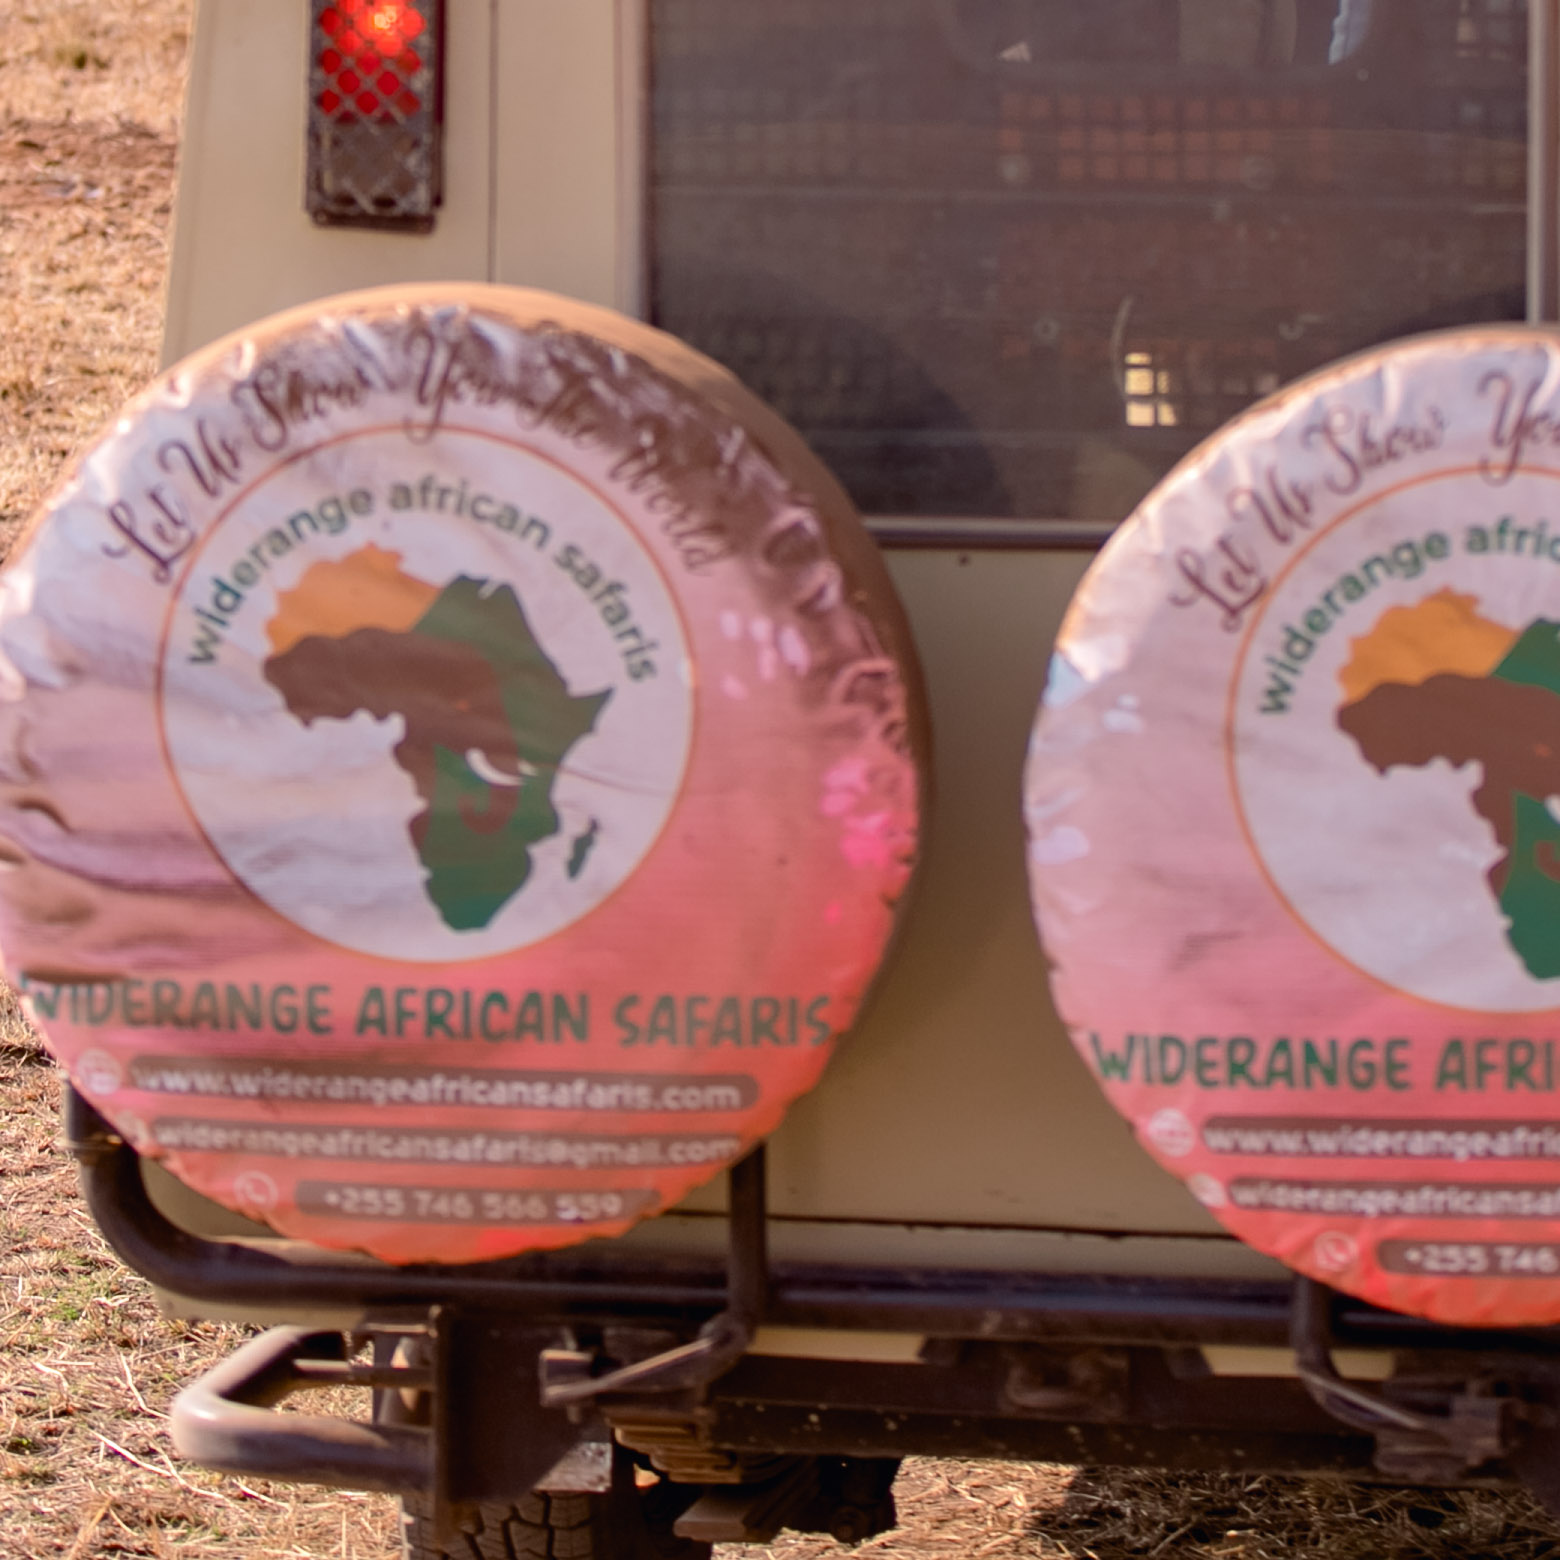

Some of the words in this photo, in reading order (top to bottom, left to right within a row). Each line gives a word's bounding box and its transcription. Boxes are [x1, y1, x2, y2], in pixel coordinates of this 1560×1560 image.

[102, 485, 198, 584] Let
[157, 419, 242, 499] Us
[1168, 535, 1268, 634] Let
[1226, 462, 1314, 545] Us
[1302, 400, 1447, 496] Show
[187, 485, 375, 666] widerange
[387, 474, 552, 550] african
[552, 542, 658, 684] safaris
[1258, 531, 1452, 717] widerange
[354, 985, 590, 1043] AFRICAN
[612, 992, 834, 1047] SAFARIS
[1088, 1032, 1414, 1092] WIDERANGE
[324, 1185, 406, 1217] +255
[413, 1189, 476, 1220] 746
[1404, 1244, 1490, 1272] +255
[1494, 1244, 1559, 1273] 746
